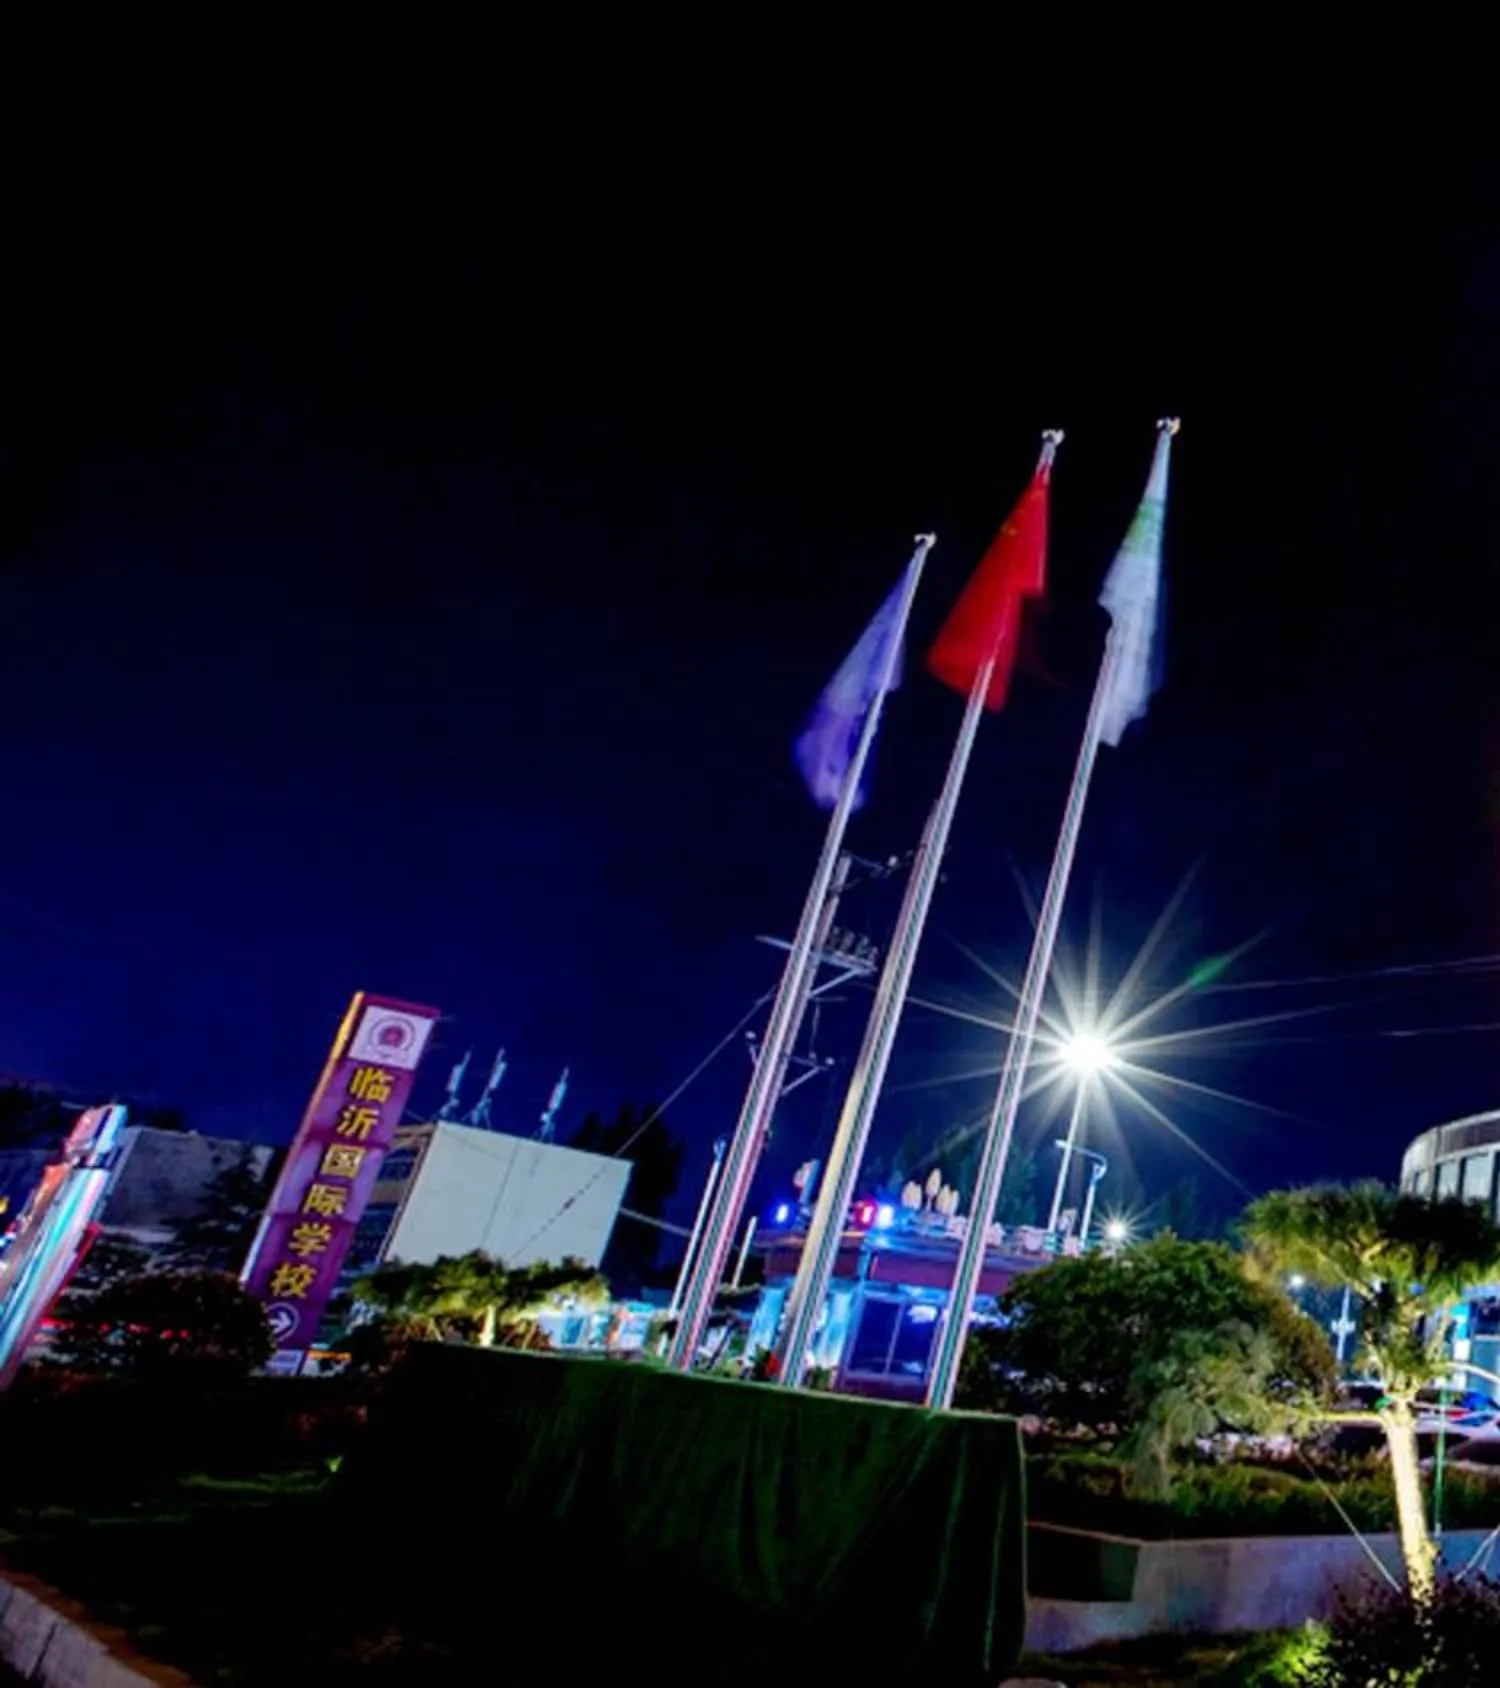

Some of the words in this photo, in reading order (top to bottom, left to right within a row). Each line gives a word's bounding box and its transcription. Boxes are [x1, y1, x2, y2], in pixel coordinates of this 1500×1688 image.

[269, 1066, 396, 1299] 临沂国际学校
